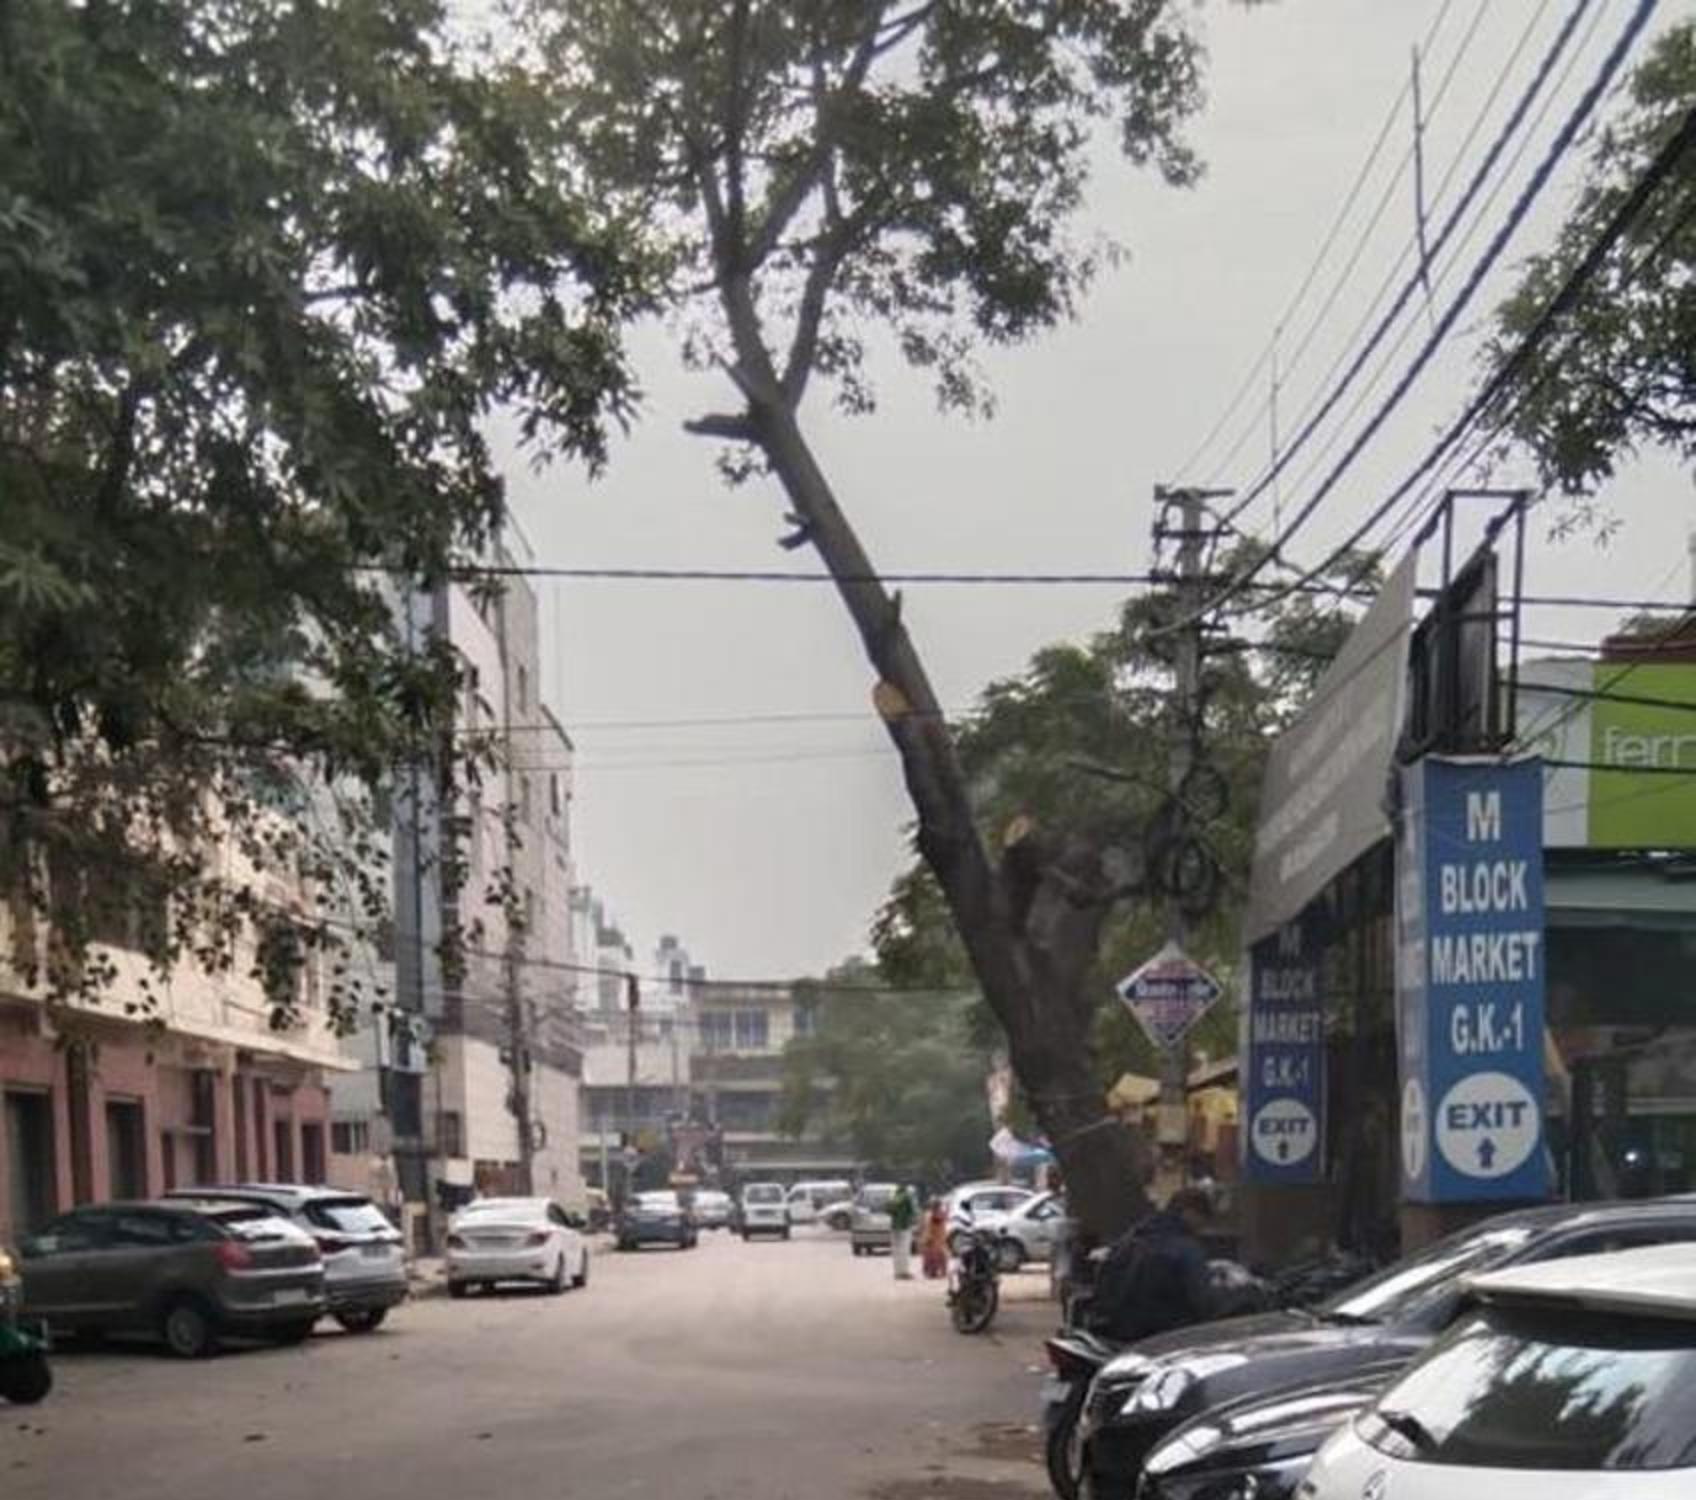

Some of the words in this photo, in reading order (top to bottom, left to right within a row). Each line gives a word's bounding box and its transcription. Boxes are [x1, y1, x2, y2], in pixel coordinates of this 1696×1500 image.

[1467, 791, 1500, 841] M
[1440, 861, 1527, 914] BLOCK
[1431, 931, 1539, 985] MARKET
[1451, 1003, 1523, 1054] G.K.-1
[1258, 1118, 1310, 1135] EXIT
[1447, 1101, 1527, 1130] EXIT
